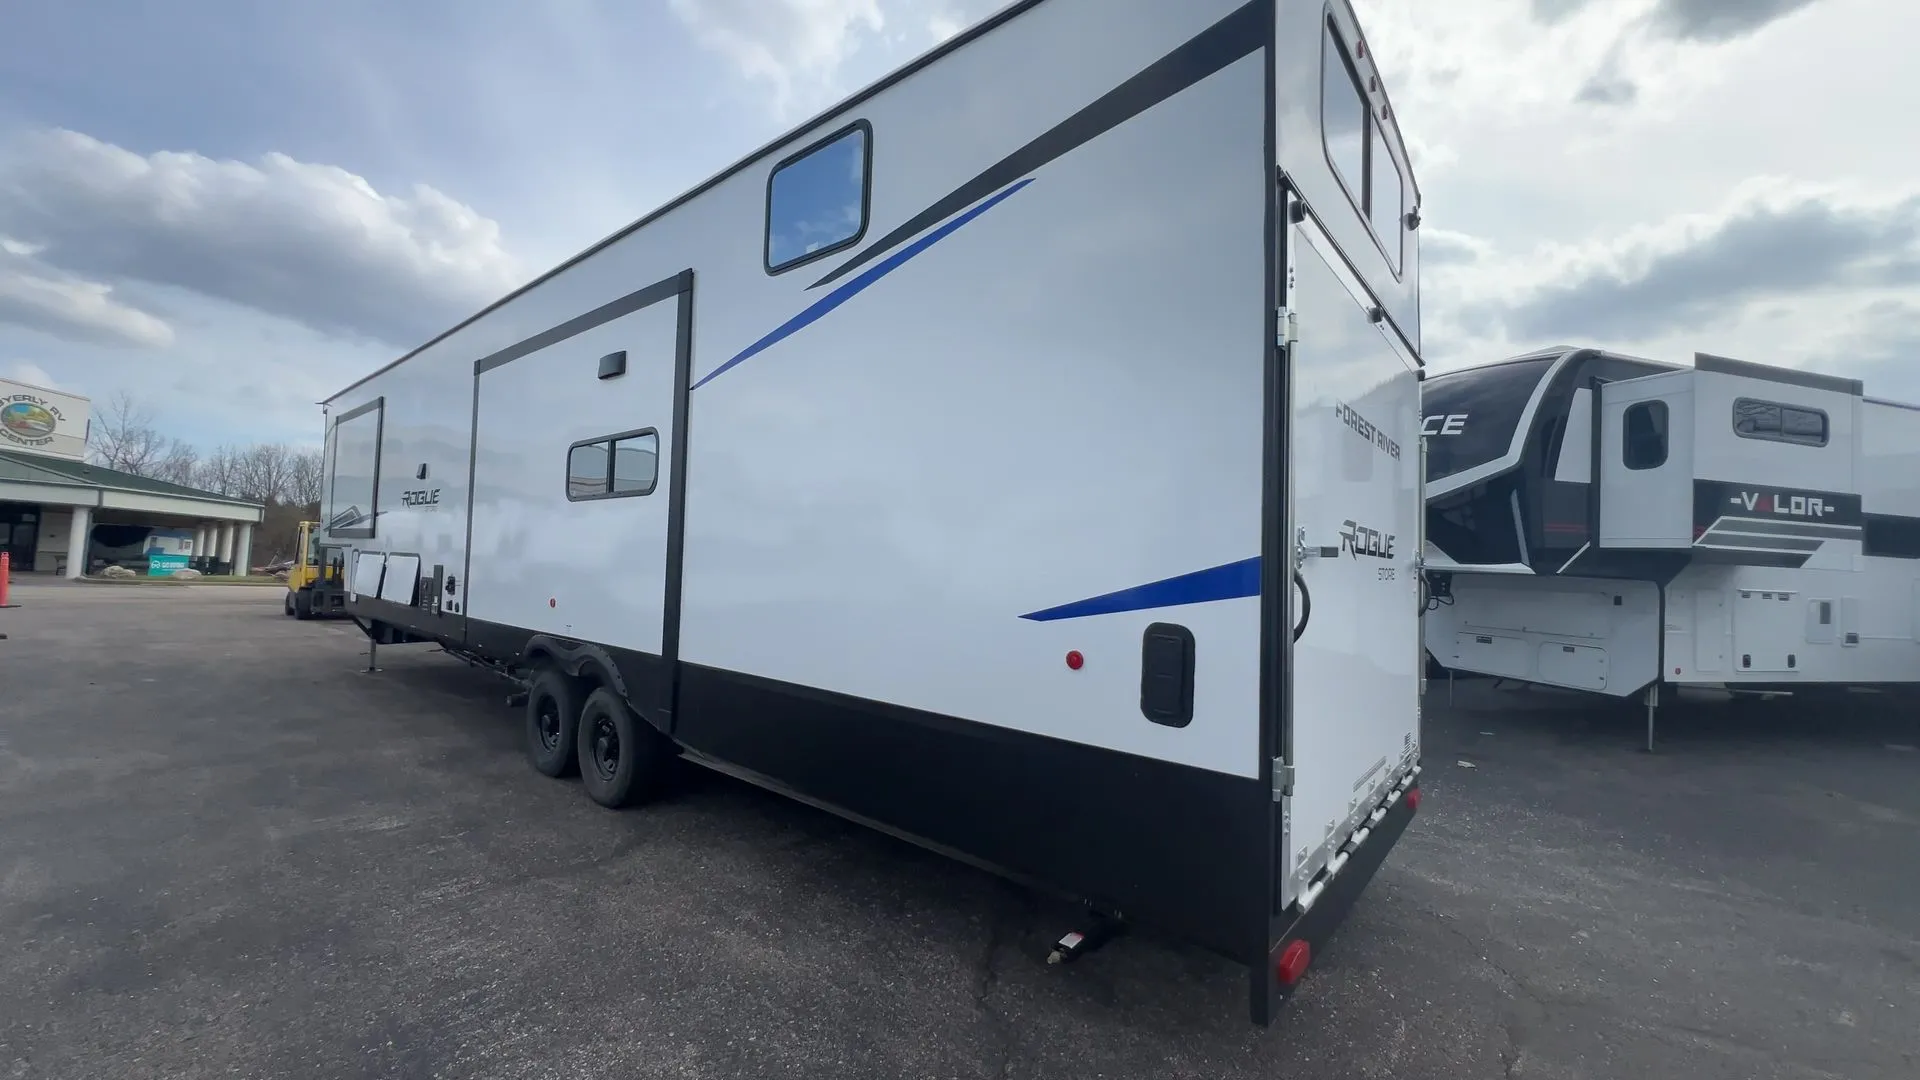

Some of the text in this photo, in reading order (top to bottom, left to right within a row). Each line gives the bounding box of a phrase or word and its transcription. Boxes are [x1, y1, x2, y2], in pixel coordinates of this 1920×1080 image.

[49, 406, 66, 421] RV
[0, 428, 54, 446] CENTER
[1335, 400, 1400, 461] FOREST RIVER
[401, 488, 441, 509] ROGUE
[1339, 519, 1396, 561] ROGUE
